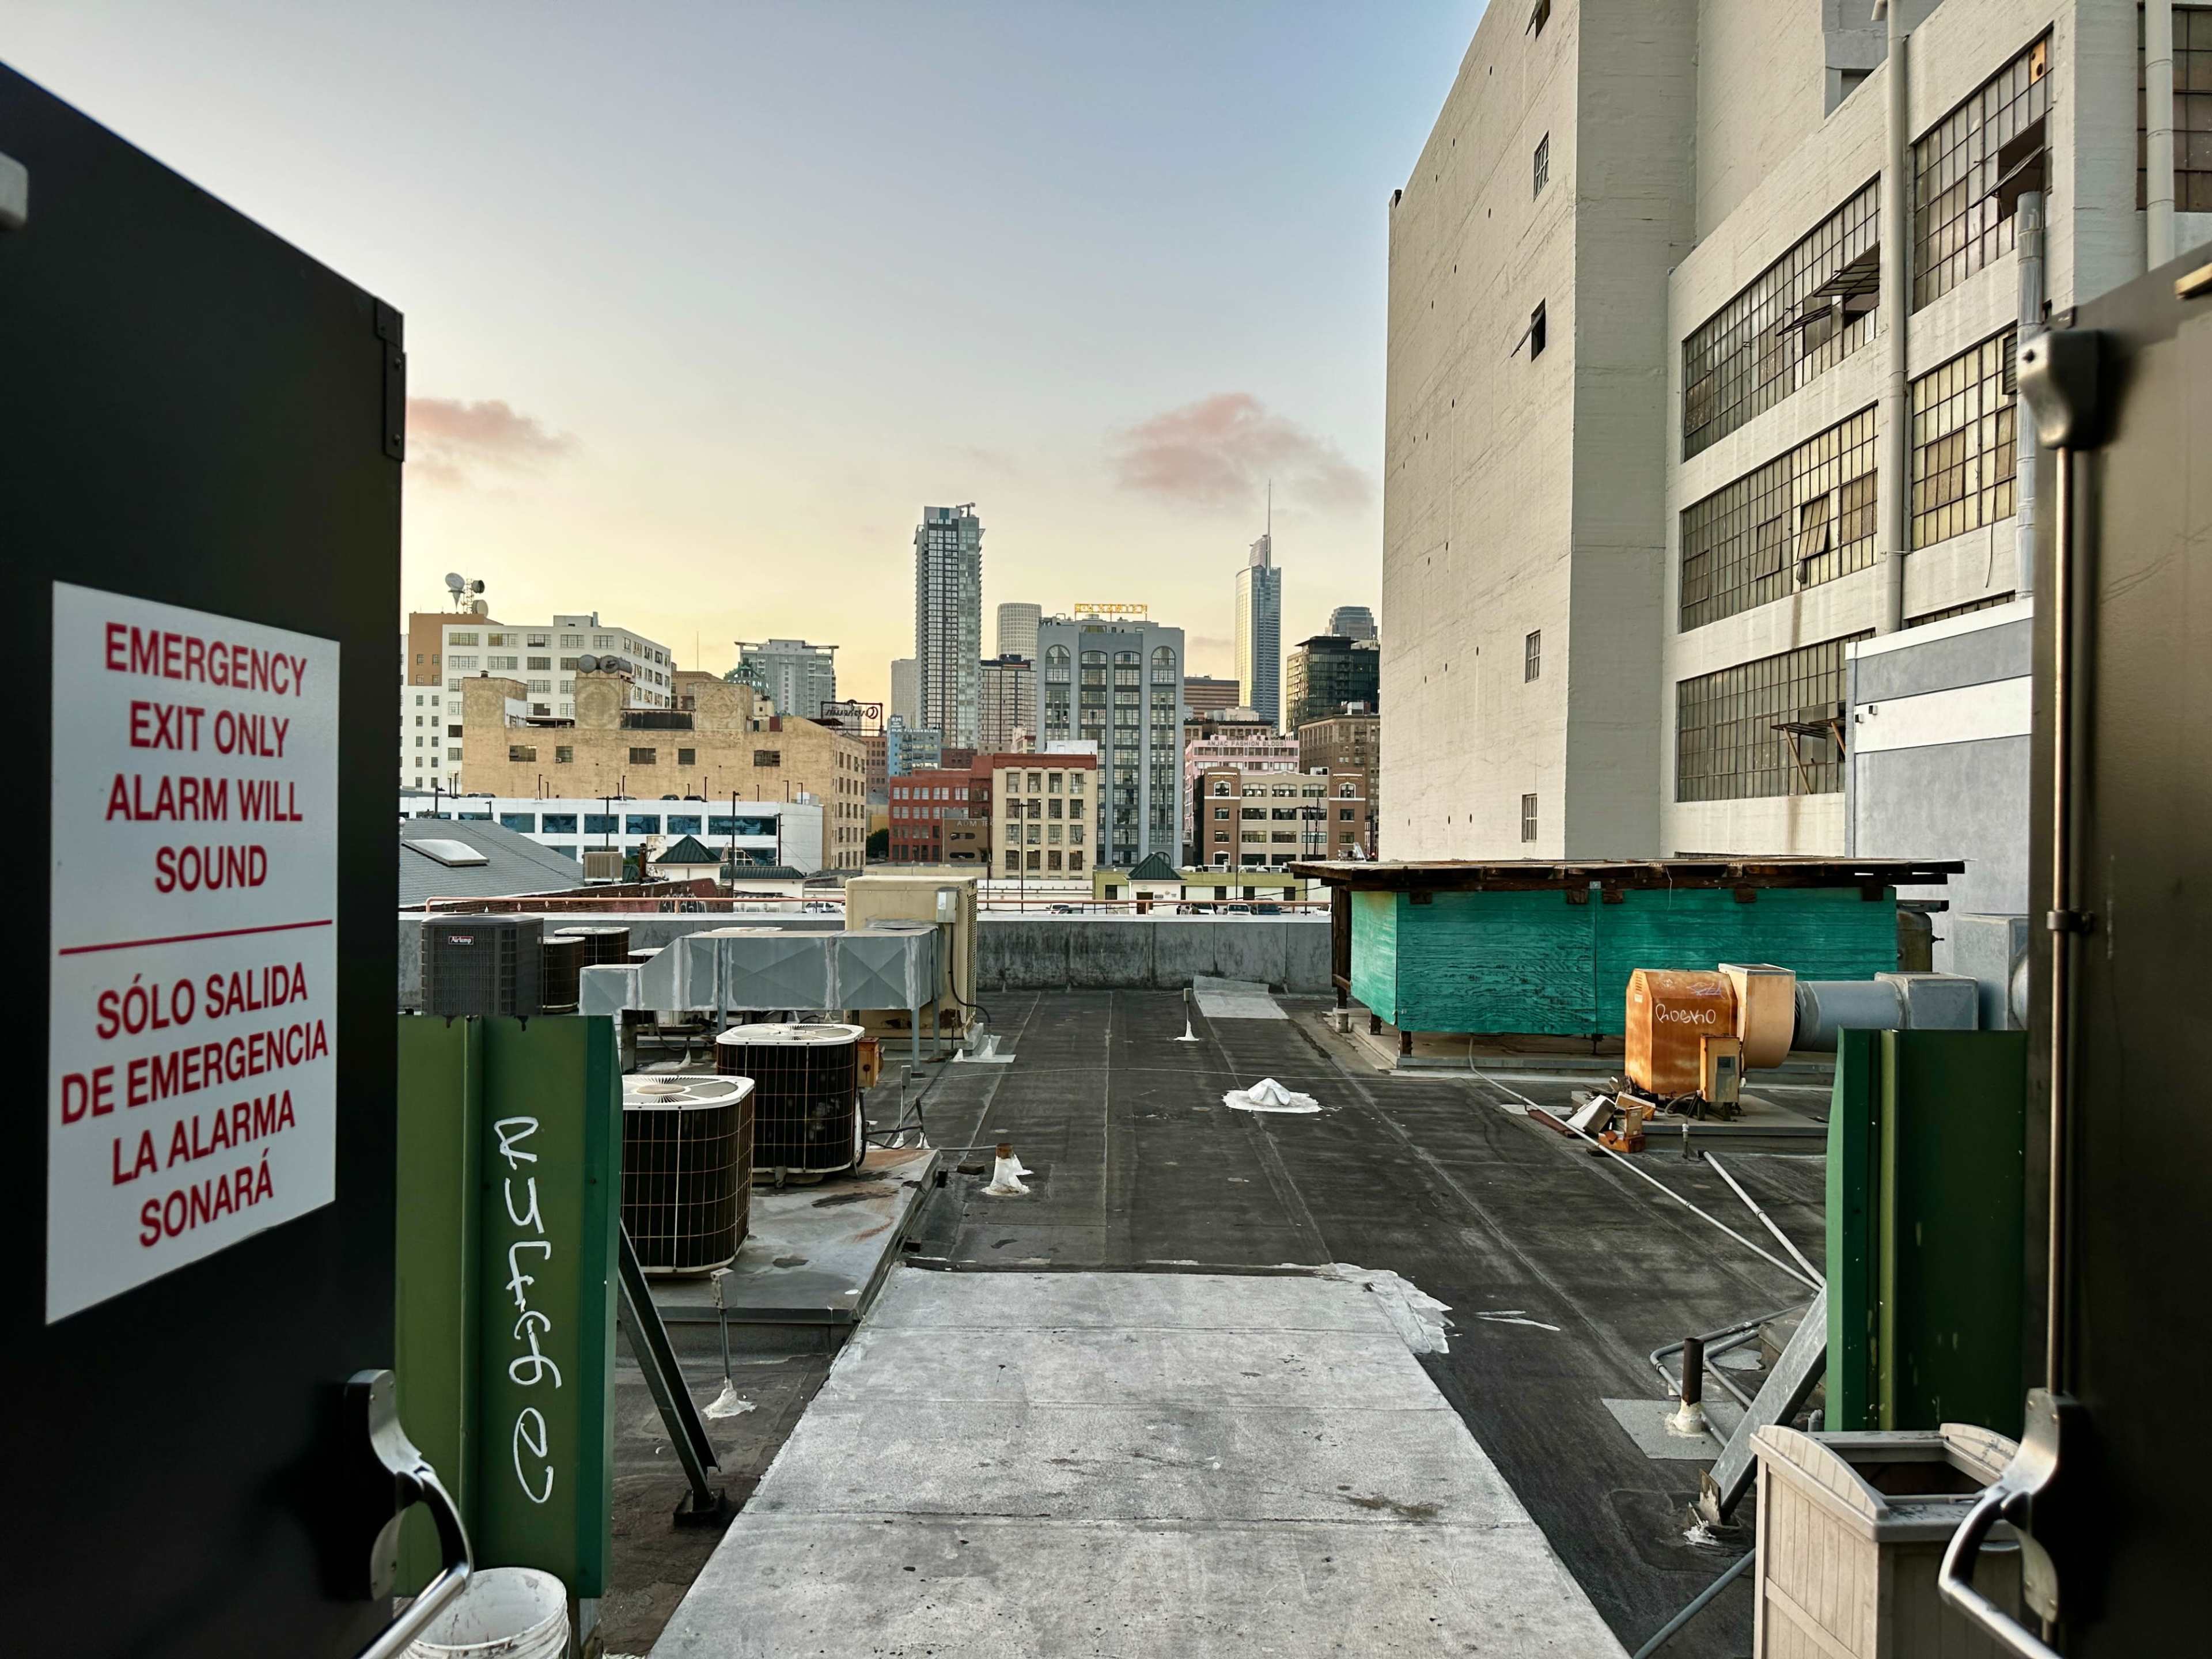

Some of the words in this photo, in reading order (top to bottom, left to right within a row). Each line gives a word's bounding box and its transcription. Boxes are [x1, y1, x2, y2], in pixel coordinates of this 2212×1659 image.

[106, 622, 306, 695] EMERGENCY
[131, 701, 204, 751] EXIT
[215, 710, 289, 757] ONLY
[105, 774, 228, 821] ALARM
[238, 779, 303, 822] WILL
[155, 844, 268, 893] SOUND
[96, 973, 195, 1039] SÓLO
[205, 962, 308, 1018] SALIDA
[62, 1065, 115, 1125] DE
[126, 1019, 329, 1107] EMERGENCIA
[112, 1130, 158, 1185] LA
[167, 1089, 296, 1168] ALARMA
[139, 1147, 274, 1248] SONARÁ
